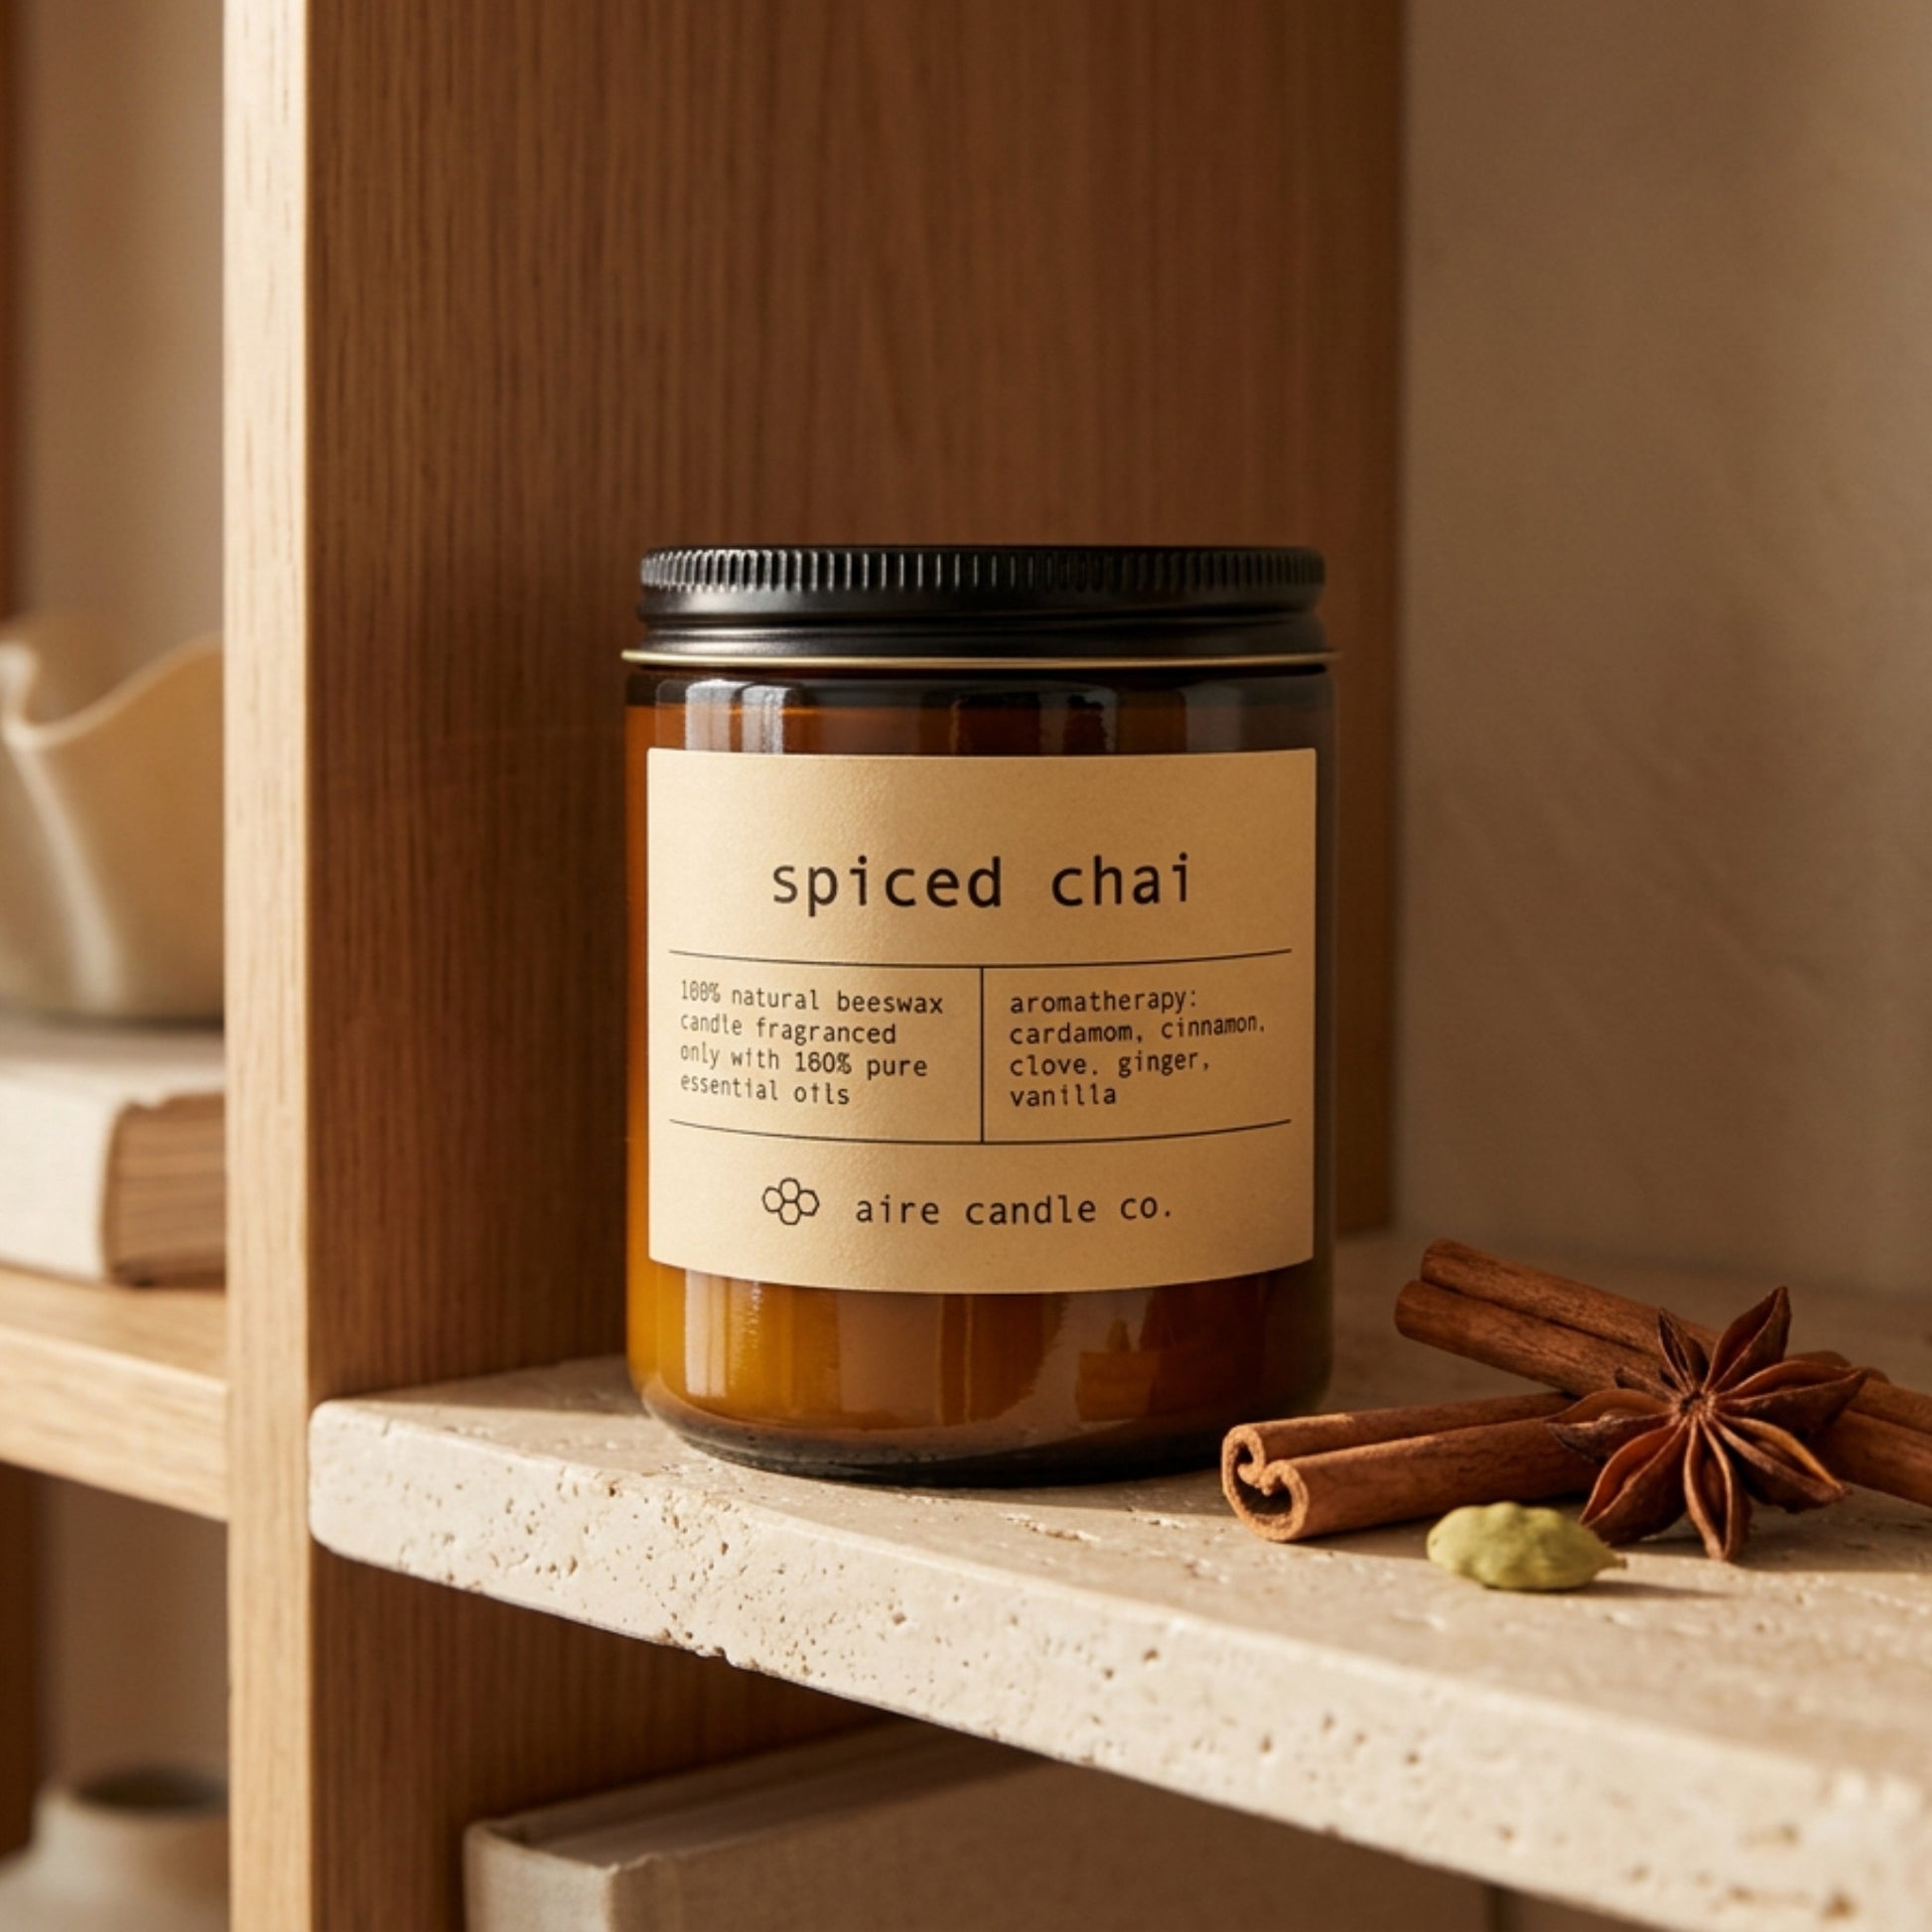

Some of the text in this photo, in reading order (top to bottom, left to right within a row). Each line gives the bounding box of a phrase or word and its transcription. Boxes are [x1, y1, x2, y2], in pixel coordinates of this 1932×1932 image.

[771, 851, 1188, 918] spiced chai
[731, 987, 820, 1011] natural
[837, 989, 943, 1015] beeswax
[1010, 990, 1197, 1015] aromatherapy:
[680, 1013, 897, 1046] candle fragranced
[1010, 1022, 1144, 1045] cardamom,
[680, 1040, 721, 1070] only
[730, 1047, 779, 1070] with
[866, 1058, 928, 1081] pure
[1118, 1049, 1209, 1079] ginger,
[680, 1074, 778, 1101] essential
[1010, 1083, 1117, 1108] vanilla
[855, 1193, 1172, 1226] aire candle co.
